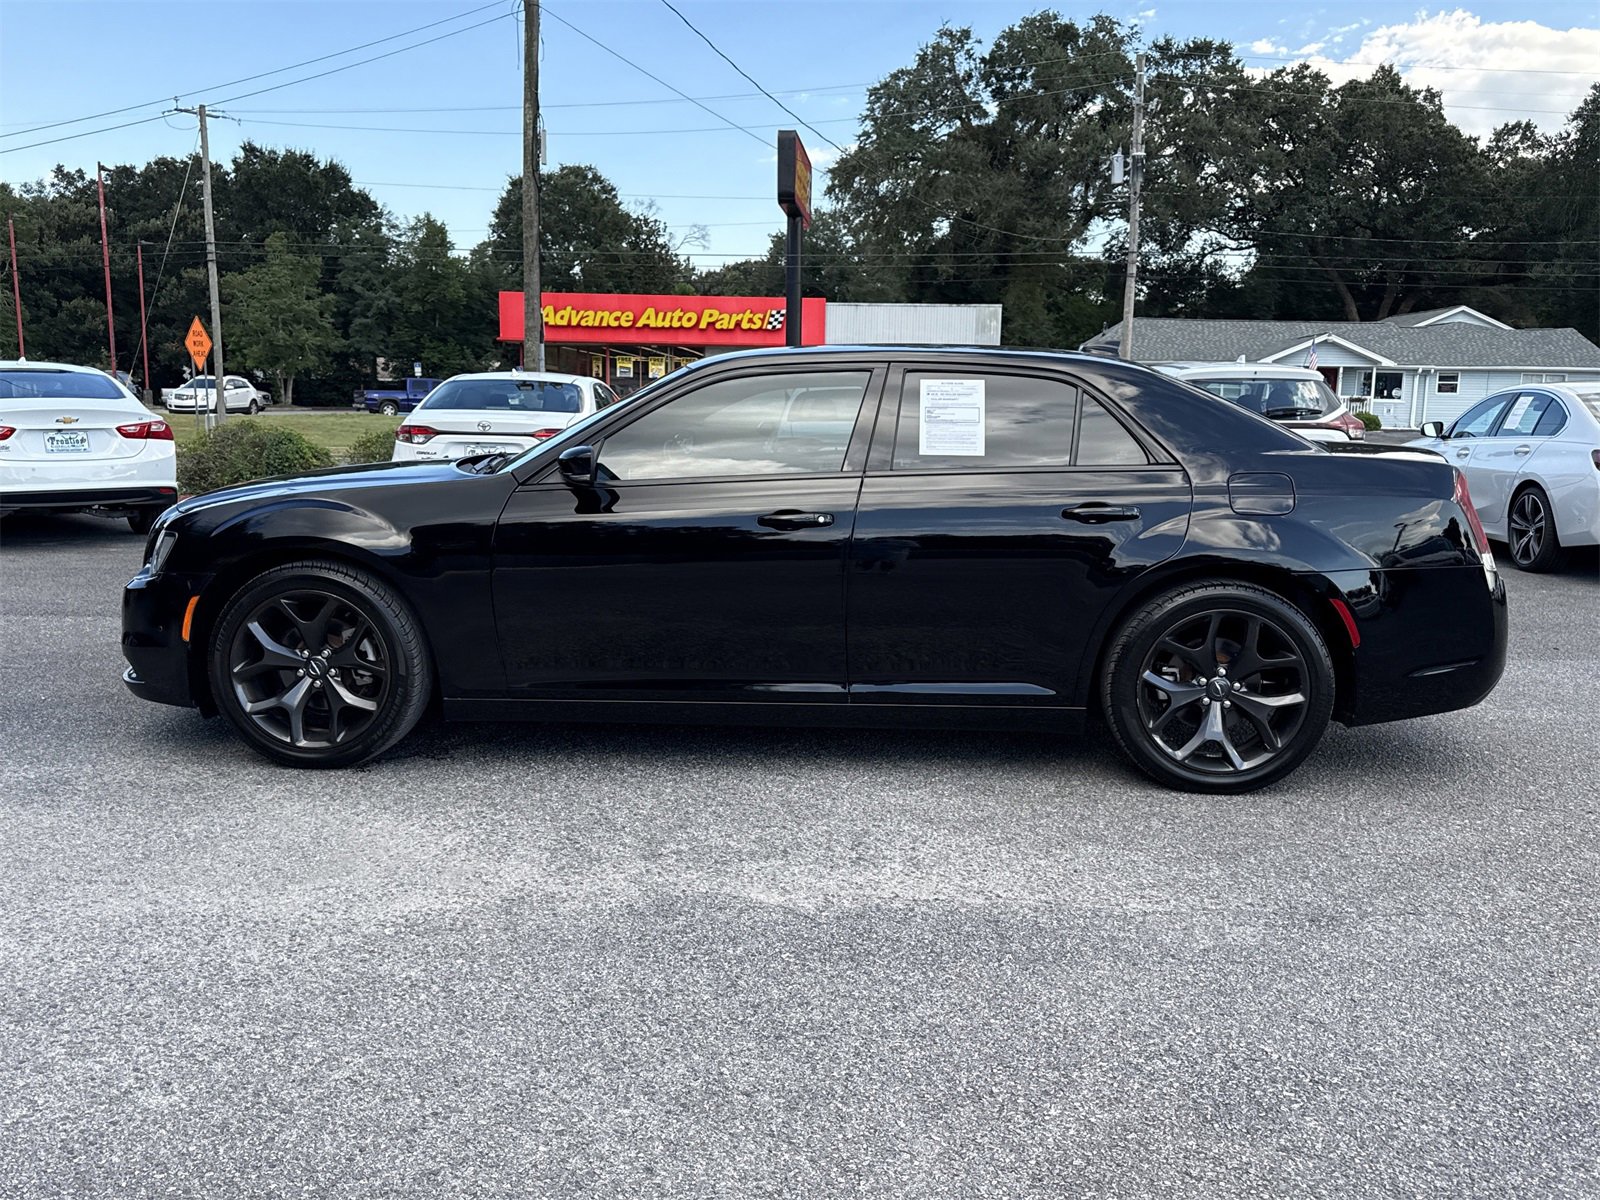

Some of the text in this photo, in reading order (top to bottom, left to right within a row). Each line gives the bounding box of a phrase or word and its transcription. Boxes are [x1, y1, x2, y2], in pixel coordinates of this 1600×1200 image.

[542, 305, 763, 330] Advance Auto Parts
[192, 329, 203, 337] ROAD
